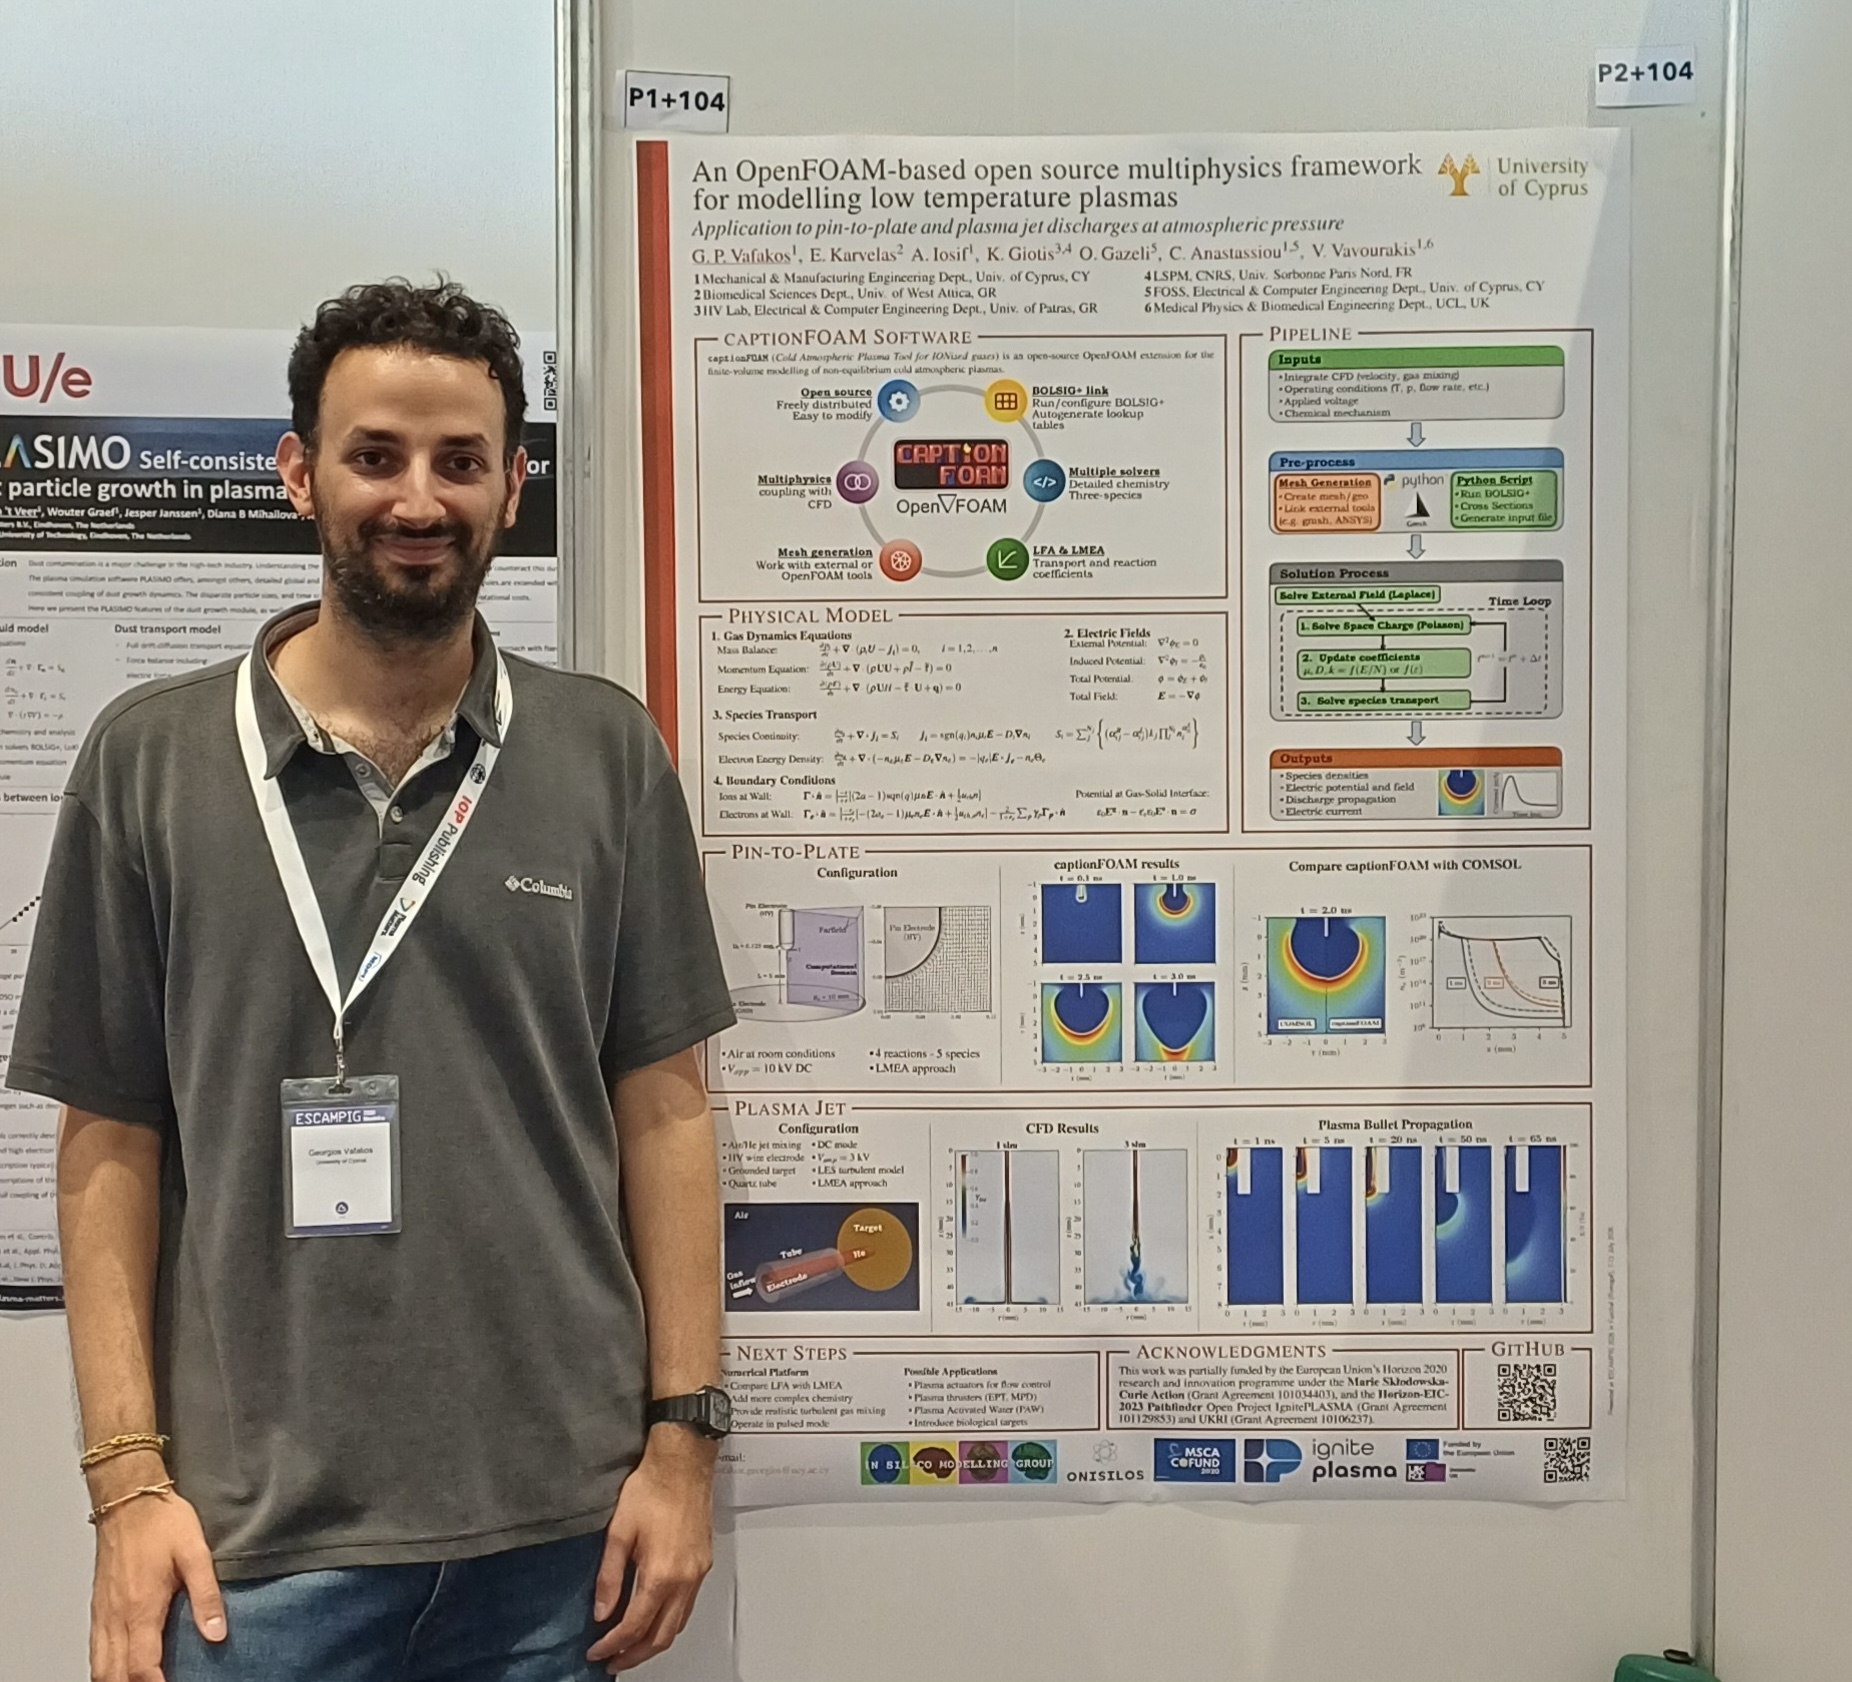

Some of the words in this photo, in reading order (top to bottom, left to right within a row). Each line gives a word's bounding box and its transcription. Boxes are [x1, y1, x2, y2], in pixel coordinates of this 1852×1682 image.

[1598, 61, 1694, 83] P2+104
[629, 87, 726, 112] P1+104
[691, 159, 727, 183] An
[735, 156, 966, 188] OpenFOAM-based
[973, 163, 1032, 187] open
[1040, 163, 1119, 180] source
[1127, 154, 1282, 186] multiphysics
[1290, 152, 1422, 177] framework
[1497, 155, 1588, 180] University
[1497, 178, 1517, 197] of
[1523, 177, 1588, 201] Cyprus
[693, 186, 730, 211] for
[737, 184, 862, 215] modelling
[870, 185, 915, 209] low
[923, 183, 1071, 213] temperature
[1079, 184, 1178, 212] plasmas
[690, 218, 792, 241] Application
[795, 221, 812, 235] to
[813, 217, 918, 240] pin-to-plate
[919, 216, 954, 235] and
[954, 217, 1019, 239] plasma
[1020, 218, 1044, 239] jet
[1045, 215, 1139, 238] discharges
[1140, 219, 1159, 234] at
[1160, 215, 1269, 238] atmospheric
[1269, 218, 1344, 236] pressure
[691, 248, 710, 264] G.
[809, 246, 826, 263] E.
[910, 246, 929, 262] A.
[986, 245, 1004, 261] K.
[1078, 245, 1097, 261] O.
[1168, 245, 1185, 261] C.
[768, 272, 780, 284] &
[783, 271, 865, 286] Manufacturing
[867, 270, 936, 286] Engineering
[938, 270, 972, 286] Dept.,
[975, 270, 1005, 283] Univ.
[1009, 270, 1023, 282] of
[1024, 270, 1068, 285] Cyprus,
[1070, 270, 1090, 282] CY
[1268, 324, 1352, 342] PIPELINE
[1278, 353, 1322, 367] Inputs
[800, 385, 832, 399] Open
[833, 386, 873, 398] source
[1085, 385, 1109, 397] link
[776, 399, 810, 412] Freely
[811, 398, 872, 412] distributed
[791, 409, 819, 423] Easy
[821, 411, 833, 420] to
[835, 409, 873, 422] modify
[0, 433, 131, 470] ASIMO
[1279, 456, 1355, 469] Pre-process
[757, 473, 832, 488] Multiphysics
[939, 464, 1010, 487] FOAM
[1068, 466, 1116, 480] Multiple
[1118, 466, 1161, 479] solvers
[1402, 472, 1444, 489] python
[1067, 478, 1114, 492] Detailed
[1115, 478, 1170, 491] chemistry
[1457, 475, 1498, 488] Python
[1500, 475, 1533, 488] Script
[8, 477, 92, 501] particle
[97, 478, 177, 502] growth
[183, 479, 204, 500] in
[47, 507, 85, 518] Wouter
[124, 508, 156, 520] Jesper
[207, 509, 237, 519] Diana
[778, 546, 809, 557] Mesh
[812, 547, 873, 560] generation
[1032, 545, 1056, 556] LFA
[1072, 544, 1105, 556] LMEA
[1279, 567, 1336, 580] Solution
[1338, 566, 1389, 579] Process
[1489, 596, 1520, 606] Time
[1522, 597, 1552, 608] Loop
[17, 624, 49, 634] model
[114, 624, 136, 634] Dust
[138, 624, 179, 636] transport
[181, 624, 221, 634] model
[1279, 752, 1333, 766] Outputs
[1284, 770, 1323, 782] Species
[1324, 770, 1369, 780] densities
[454, 795, 473, 824] IOP
[1284, 806, 1323, 816] Electric
[1324, 807, 1362, 816] current
[411, 822, 459, 886] Publishing
[1053, 857, 1138, 873] captionFOAM
[1140, 857, 1180, 869] results
[1288, 860, 1343, 875] Compare
[1344, 858, 1429, 874] captionFOAM
[1432, 858, 1459, 871] with
[1460, 857, 1522, 870] COMSOL
[816, 865, 898, 881] Configuration
[520, 877, 573, 900] Columbia
[295, 1110, 362, 1126] ESCAMPIG
[1317, 1118, 1361, 1131] Plasma
[1363, 1118, 1399, 1130] Bullet
[1400, 1117, 1473, 1133] Propagation
[777, 1121, 859, 1136] Configuration
[1025, 1121, 1054, 1134] CFD
[1056, 1121, 1099, 1134] Results
[852, 1223, 883, 1234] Target
[903, 1366, 940, 1376] Possible
[941, 1366, 998, 1378] Applications
[1117, 1365, 1140, 1375] This
[1140, 1365, 1166, 1376] work
[1167, 1367, 1187, 1376] was
[1187, 1364, 1228, 1378] partially
[1229, 1364, 1263, 1376] funded
[1263, 1363, 1277, 1377] by
[1278, 1364, 1294, 1375] the
[1295, 1364, 1341, 1377] European
[1381, 1363, 1422, 1374] Horizon
[1422, 1363, 1448, 1374] 2020
[1184, 1446, 1221, 1458] MSCA
[1311, 1436, 1375, 1462] ignite
[1170, 1456, 1220, 1469] COFUND
[1065, 1469, 1144, 1482] ONISILOS
[1311, 1460, 1397, 1483] plasma
